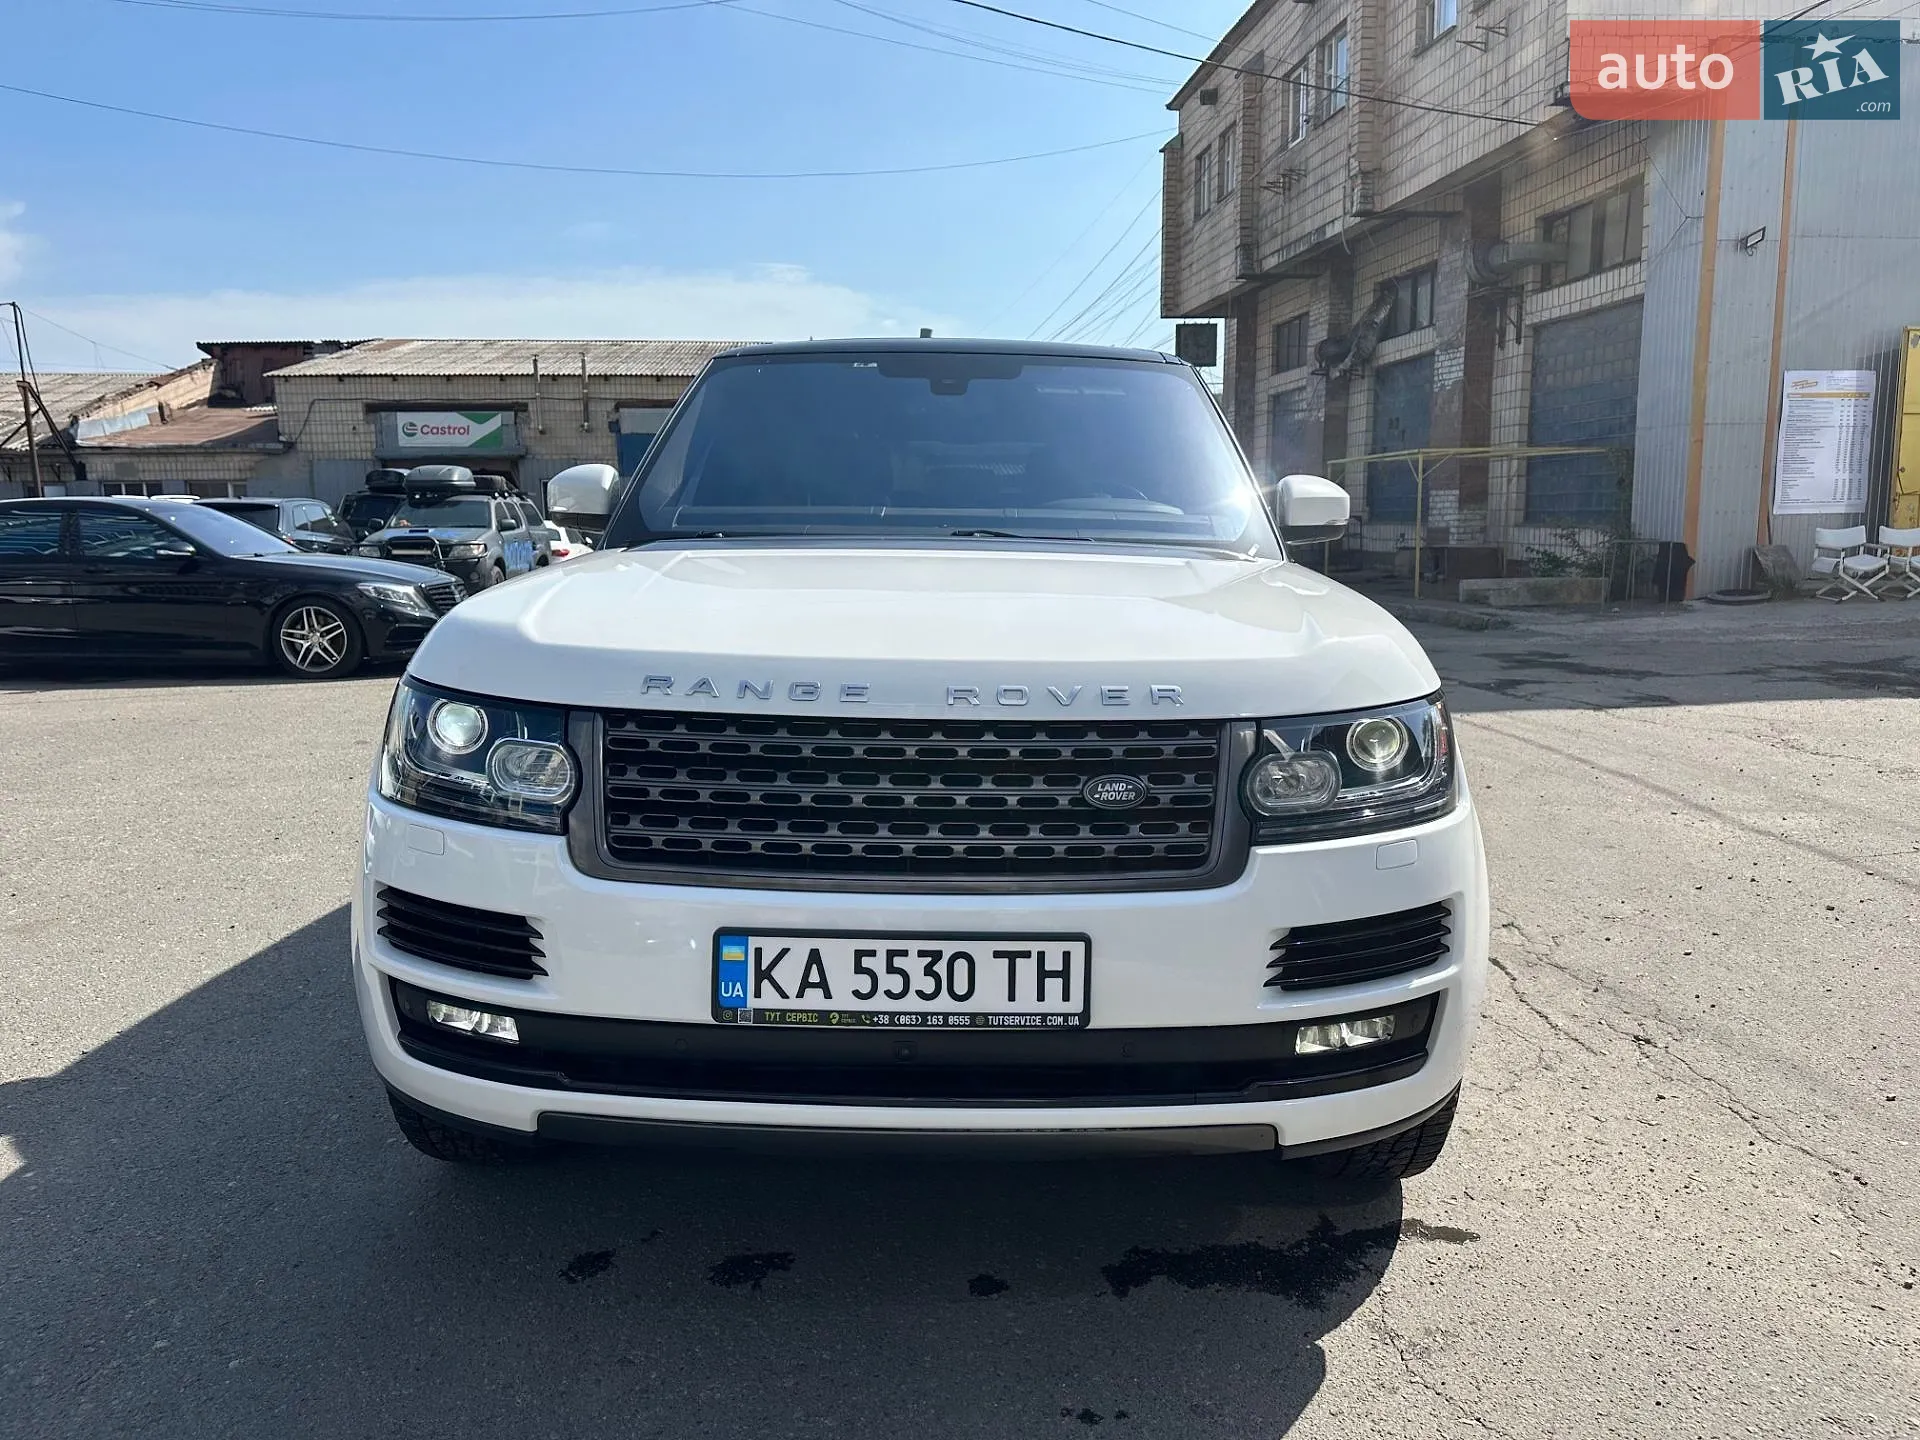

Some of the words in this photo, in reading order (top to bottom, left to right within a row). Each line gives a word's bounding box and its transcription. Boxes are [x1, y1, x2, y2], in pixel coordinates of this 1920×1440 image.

[420, 424, 470, 436] Castrol
[640, 673, 871, 703] RANGE
[946, 684, 1184, 706] ROVER
[753, 947, 833, 1000] KA
[851, 948, 976, 1003] 5530
[992, 950, 1071, 1003] TH
[721, 981, 744, 998] UA
[872, 1014, 890, 1025] +38
[894, 1014, 922, 1025] (063)
[926, 1015, 944, 1025] 163
[988, 1015, 1080, 1027] TUTSERVICE.COM.UA
